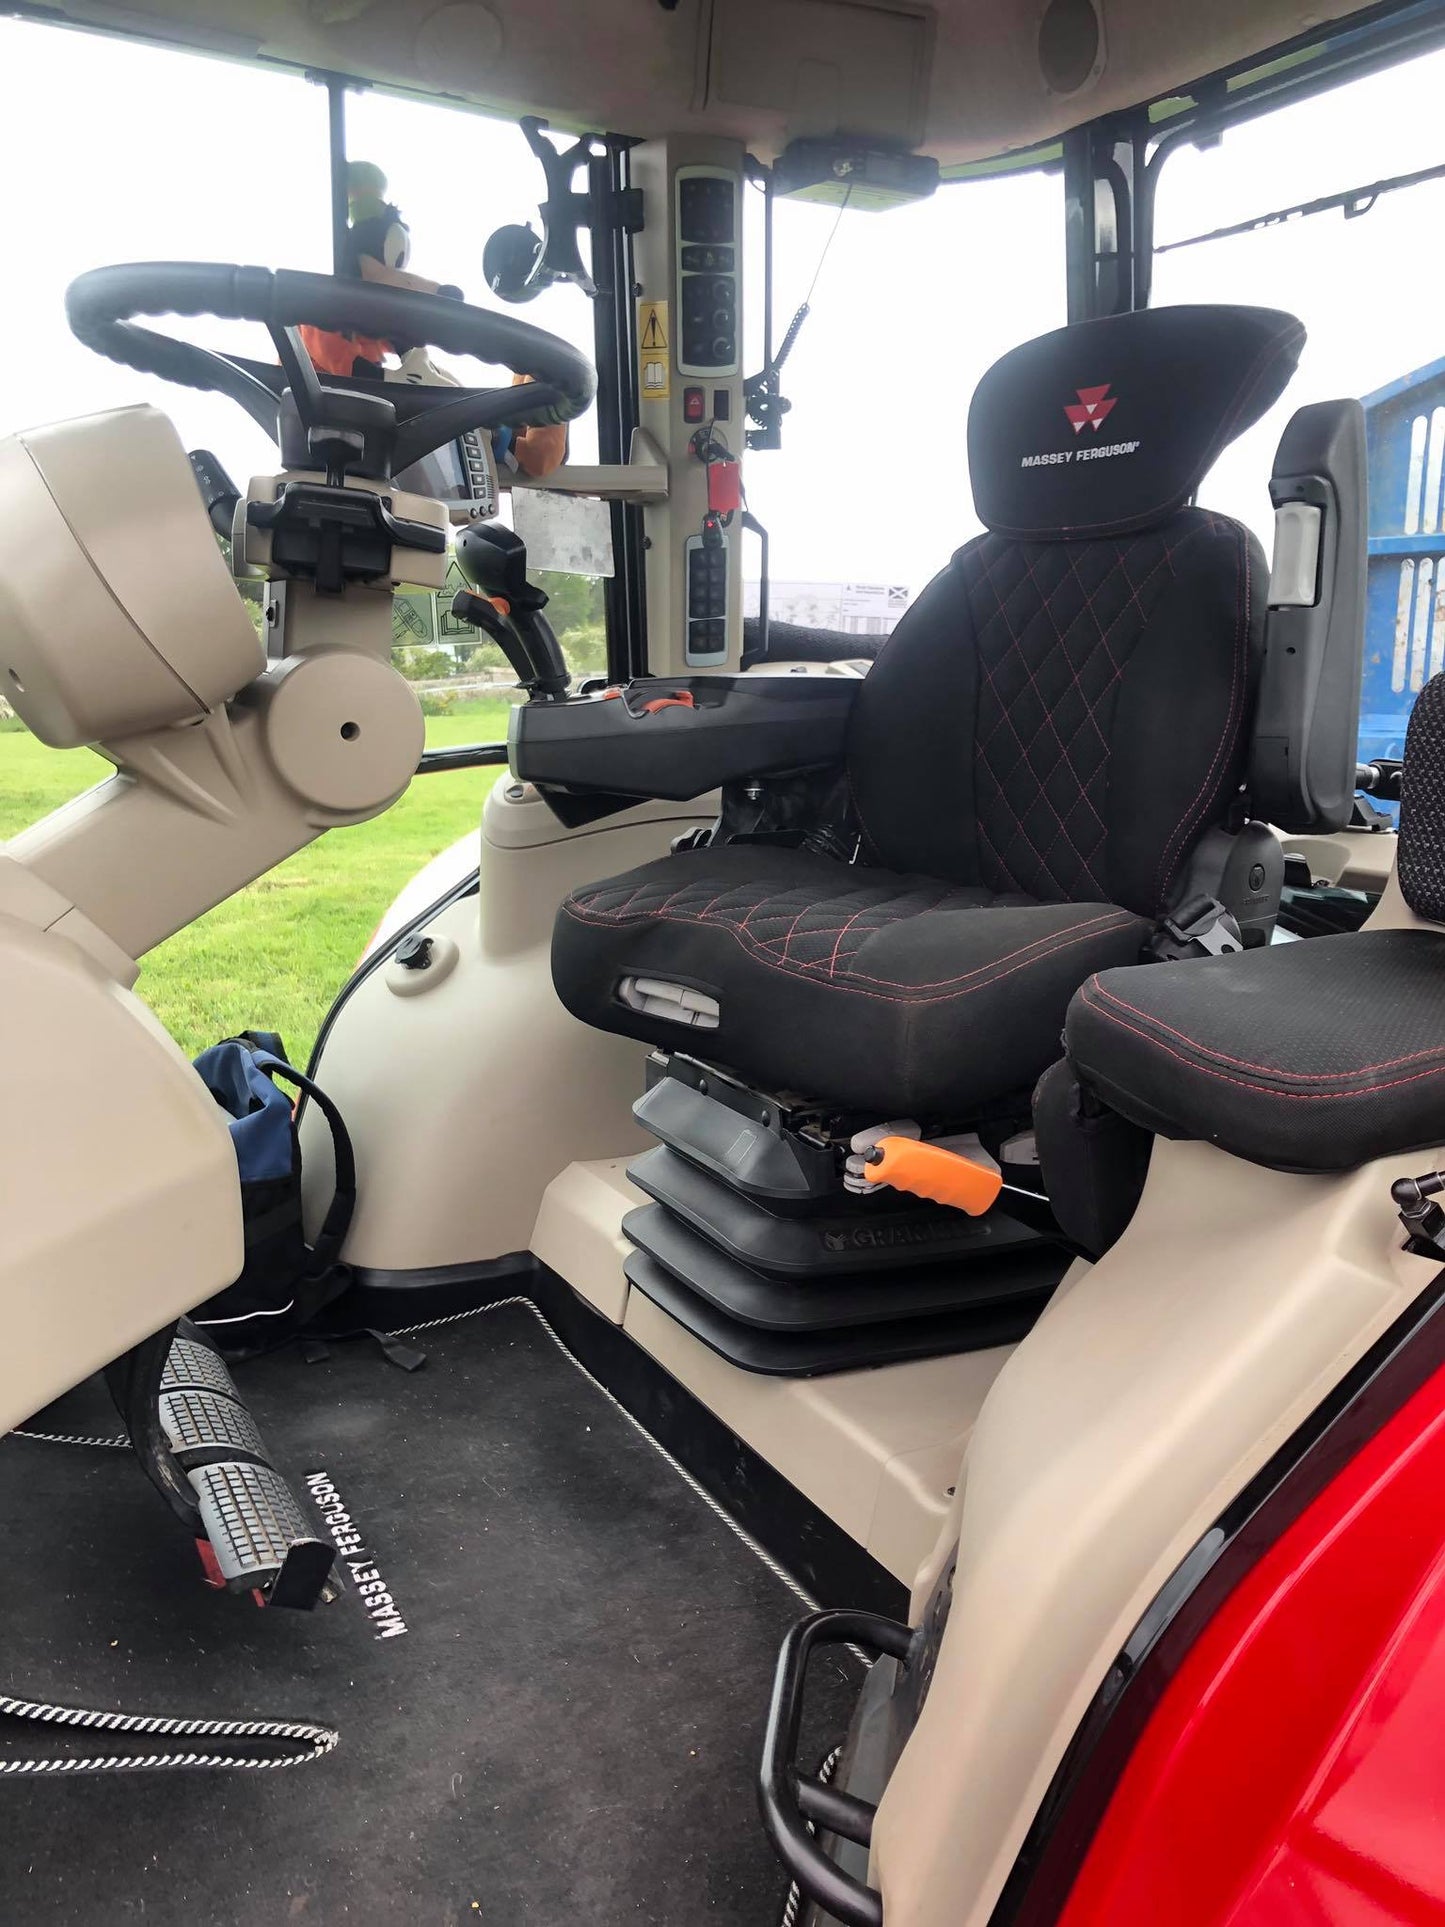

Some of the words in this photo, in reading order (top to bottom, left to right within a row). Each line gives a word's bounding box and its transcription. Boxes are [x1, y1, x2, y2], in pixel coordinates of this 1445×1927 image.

[1021, 451, 1073, 468] MASSEY
[1076, 441, 1139, 462] FERGUSON
[304, 1471, 366, 1556] FERGUSON
[346, 1559, 408, 1638] MASSEY
